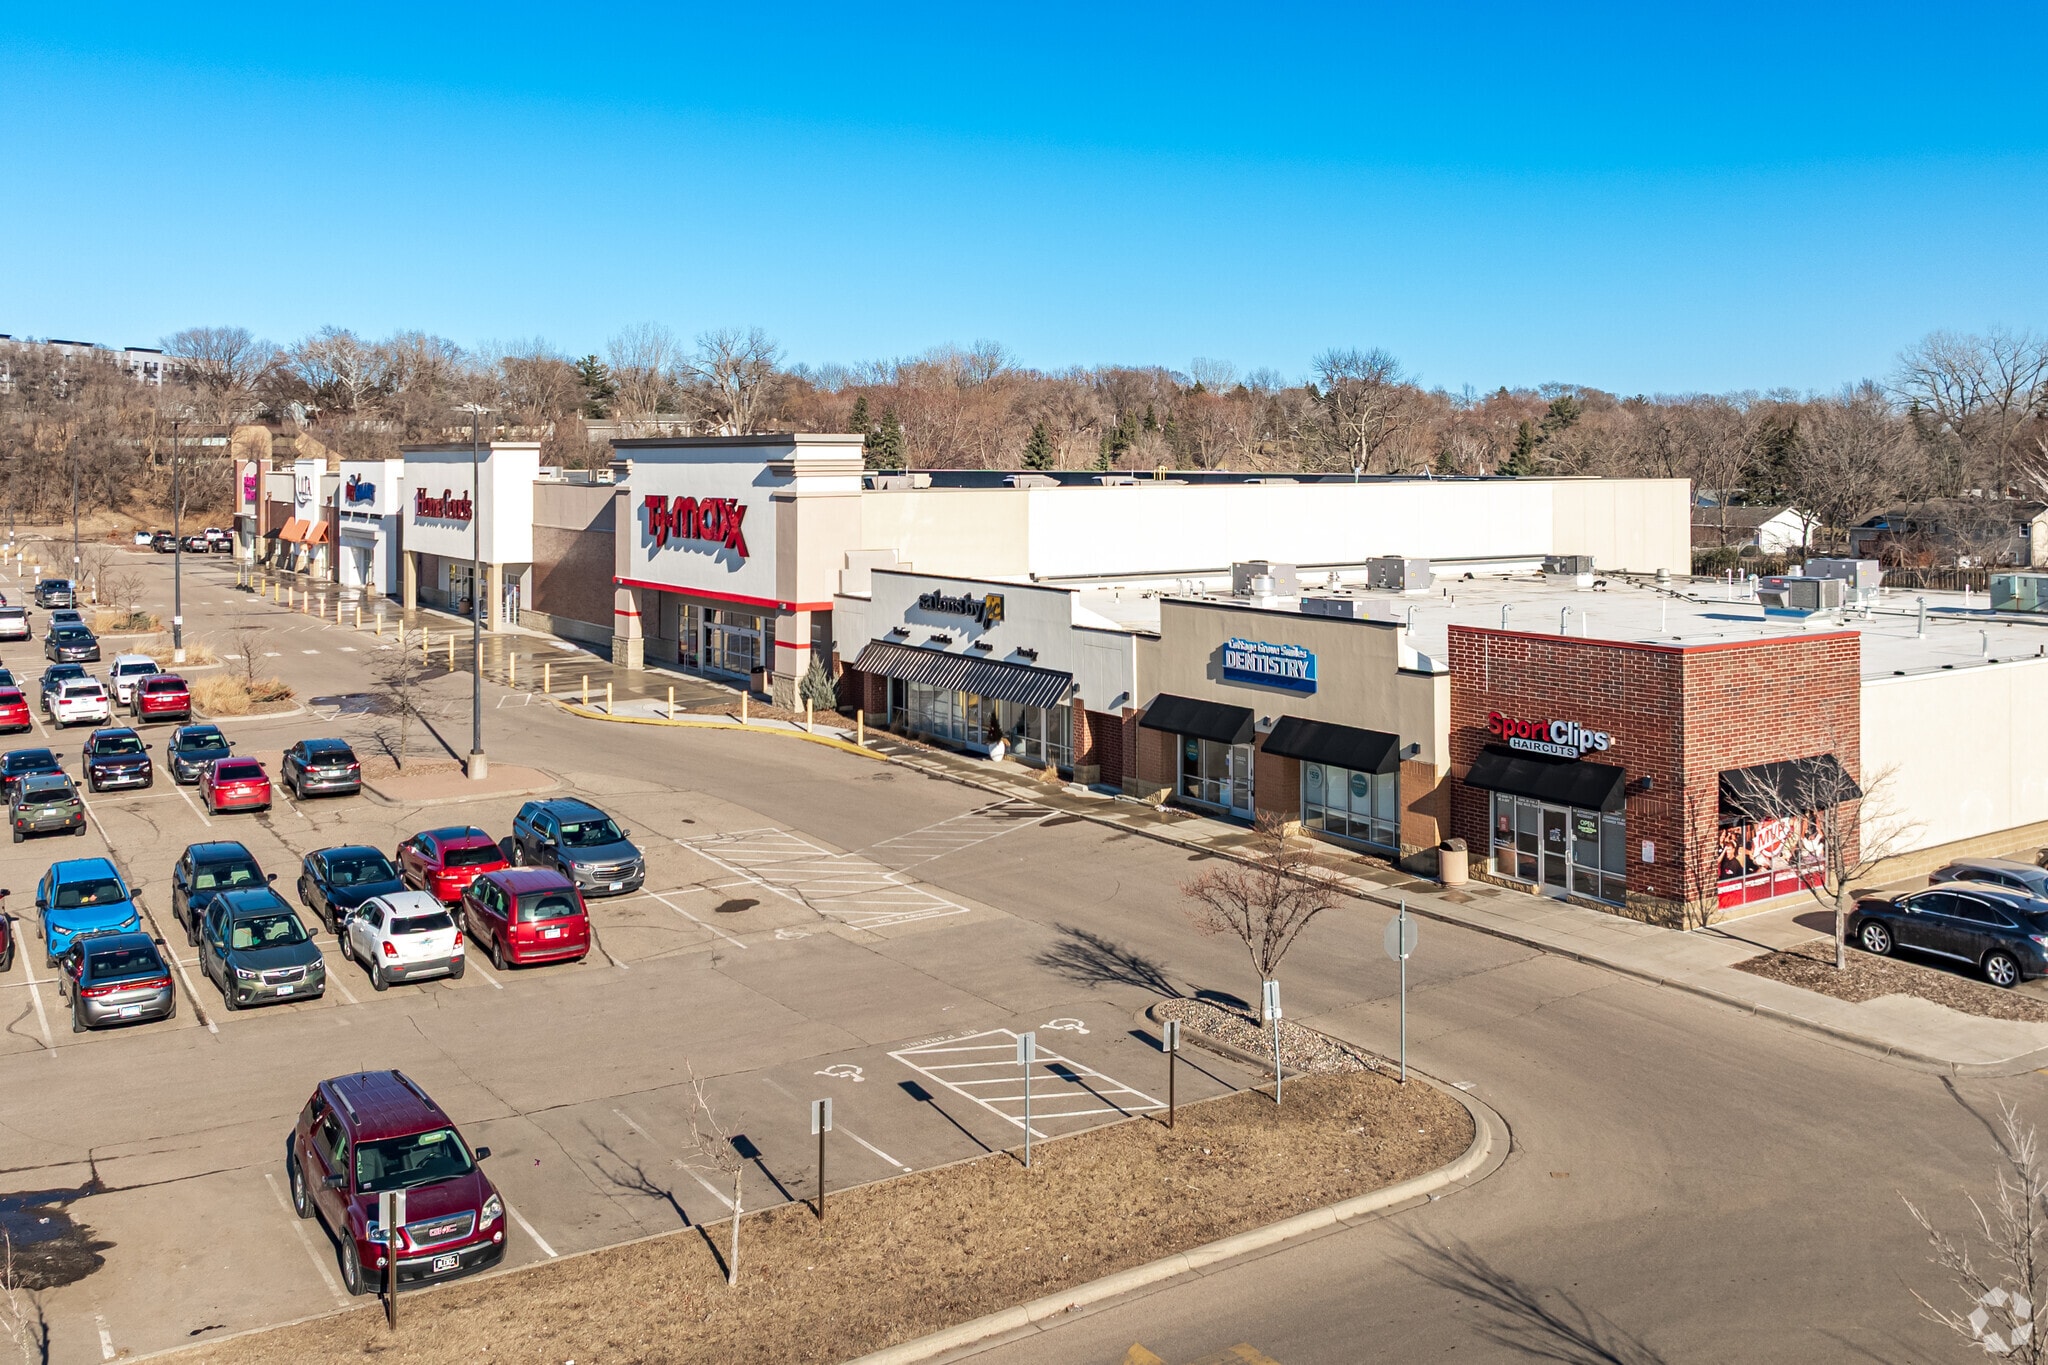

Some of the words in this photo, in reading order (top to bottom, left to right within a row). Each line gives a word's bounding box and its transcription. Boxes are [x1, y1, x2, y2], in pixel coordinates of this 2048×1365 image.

[918, 589, 963, 614] salons
[964, 592, 985, 623] by
[1225, 650, 1309, 679] DENTISTRY
[1513, 738, 1575, 757] HAIRCUTS
[1579, 819, 1595, 828] OPEN
[429, 1224, 457, 1237] GMC
